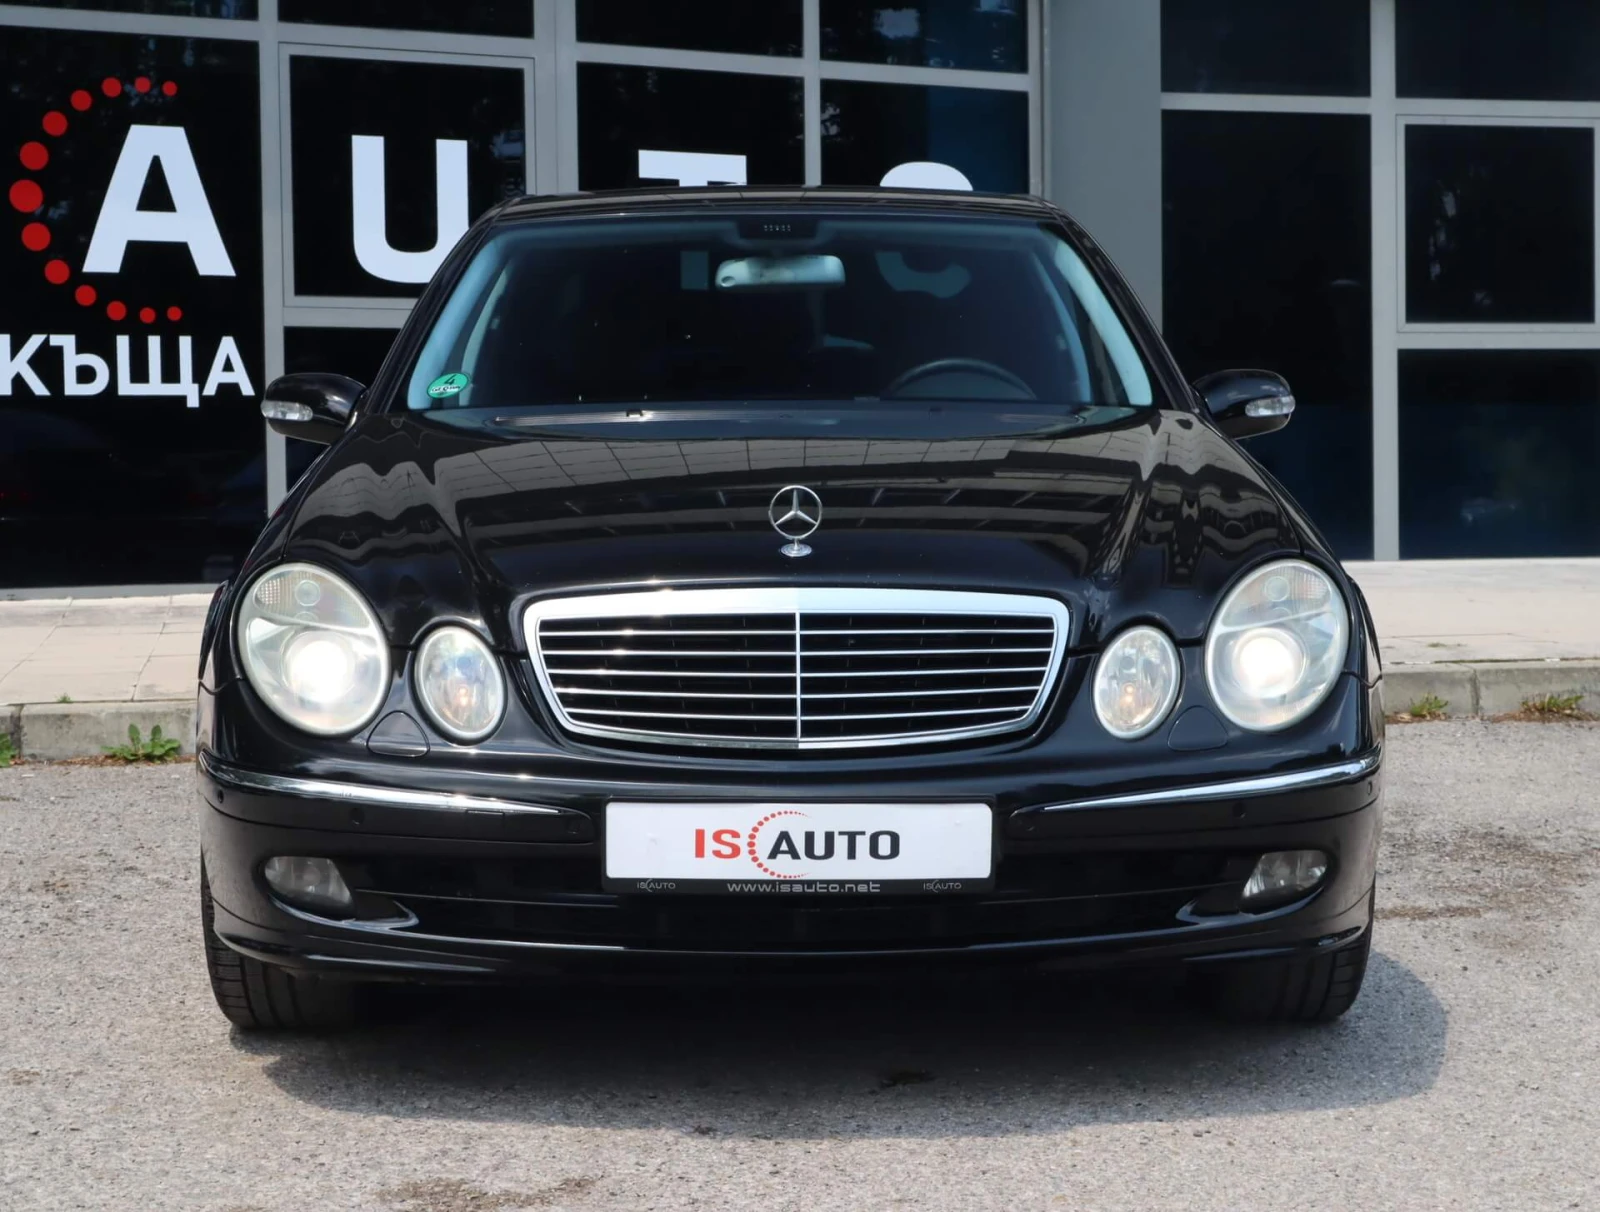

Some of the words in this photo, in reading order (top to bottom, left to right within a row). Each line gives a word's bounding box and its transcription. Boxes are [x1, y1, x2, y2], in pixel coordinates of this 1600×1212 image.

[0, 333, 256, 408] КЪЩА
[444, 374, 457, 385] 4
[766, 830, 901, 860] AUTO
[726, 881, 881, 893] www.isauto.net
